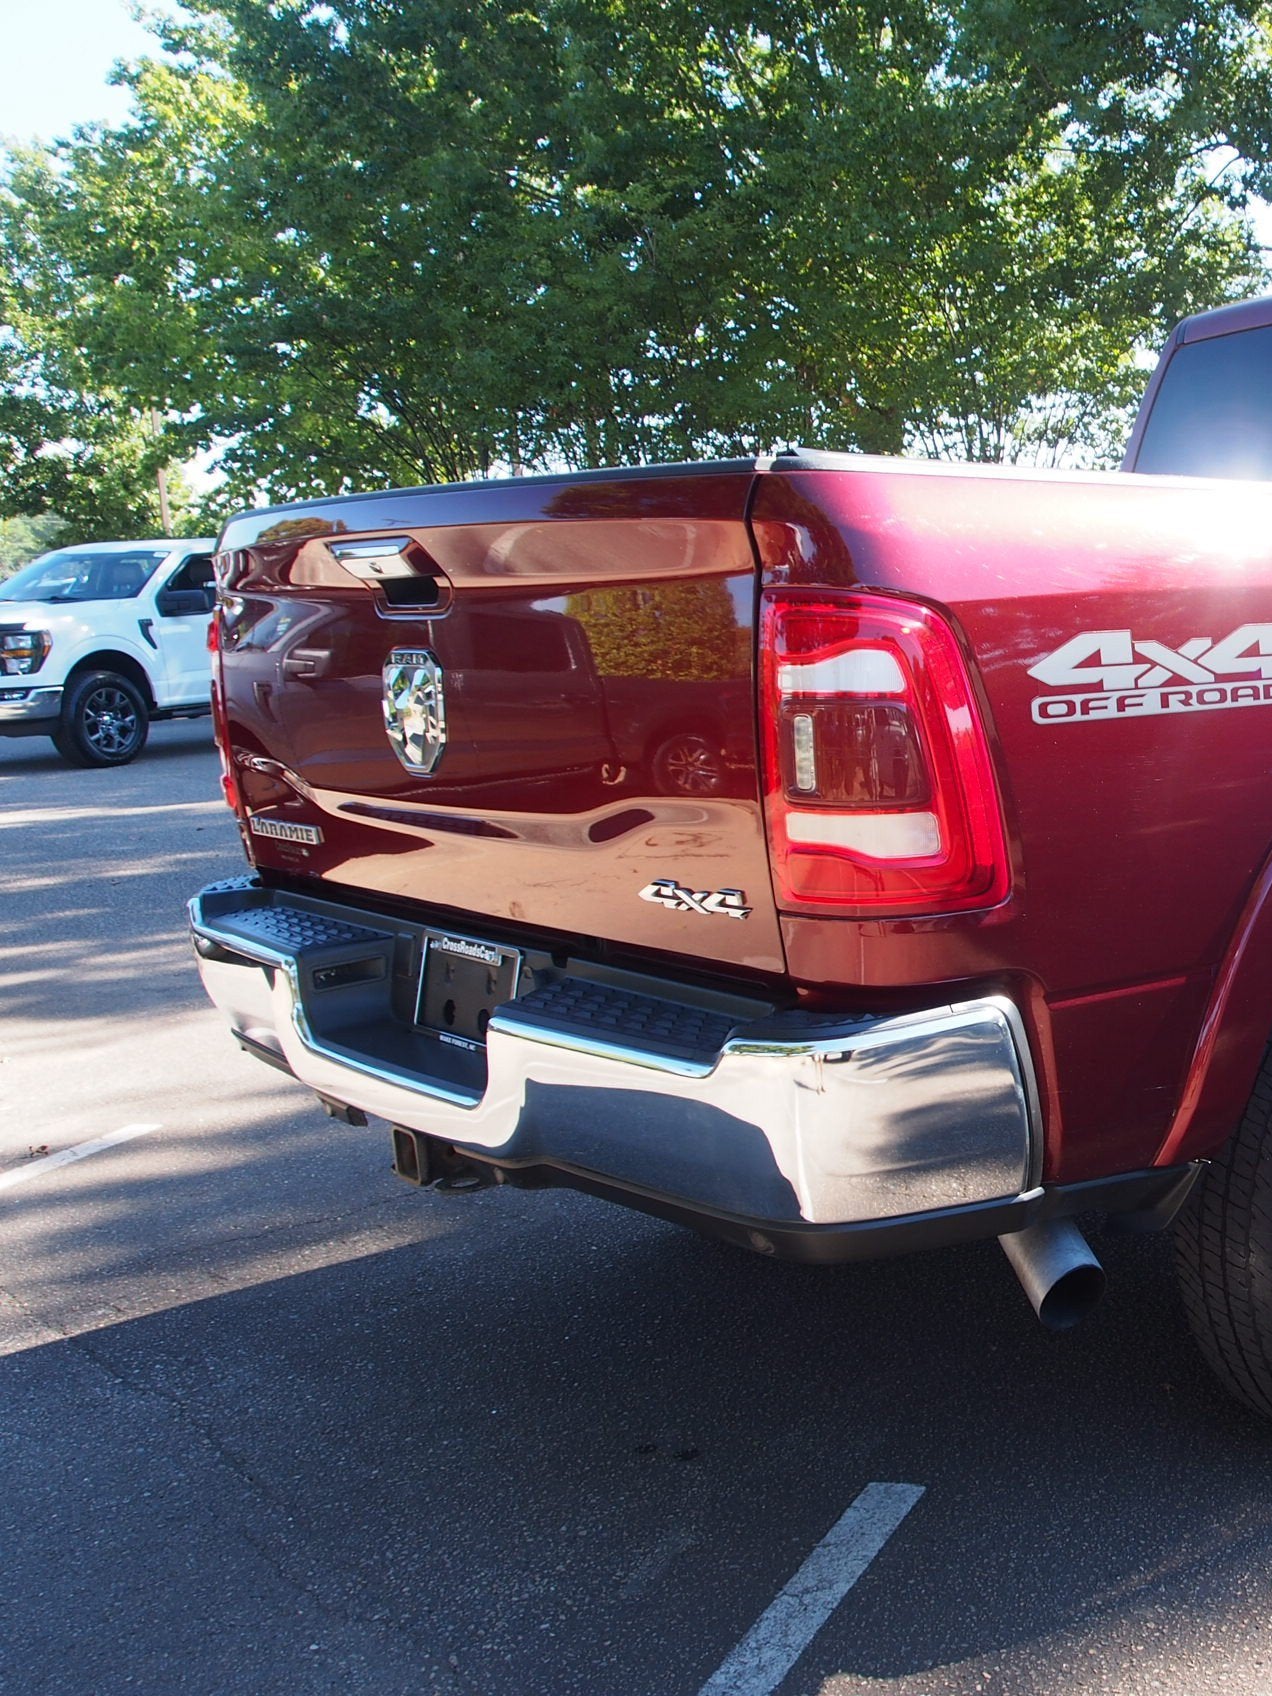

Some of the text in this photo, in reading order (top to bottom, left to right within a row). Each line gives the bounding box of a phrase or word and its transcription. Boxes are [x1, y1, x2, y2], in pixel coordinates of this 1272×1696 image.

[391, 653, 425, 665] RAM
[1037, 692, 1149, 720] OFF
[251, 817, 317, 844] LARAMIE
[637, 878, 754, 920] 4x4
